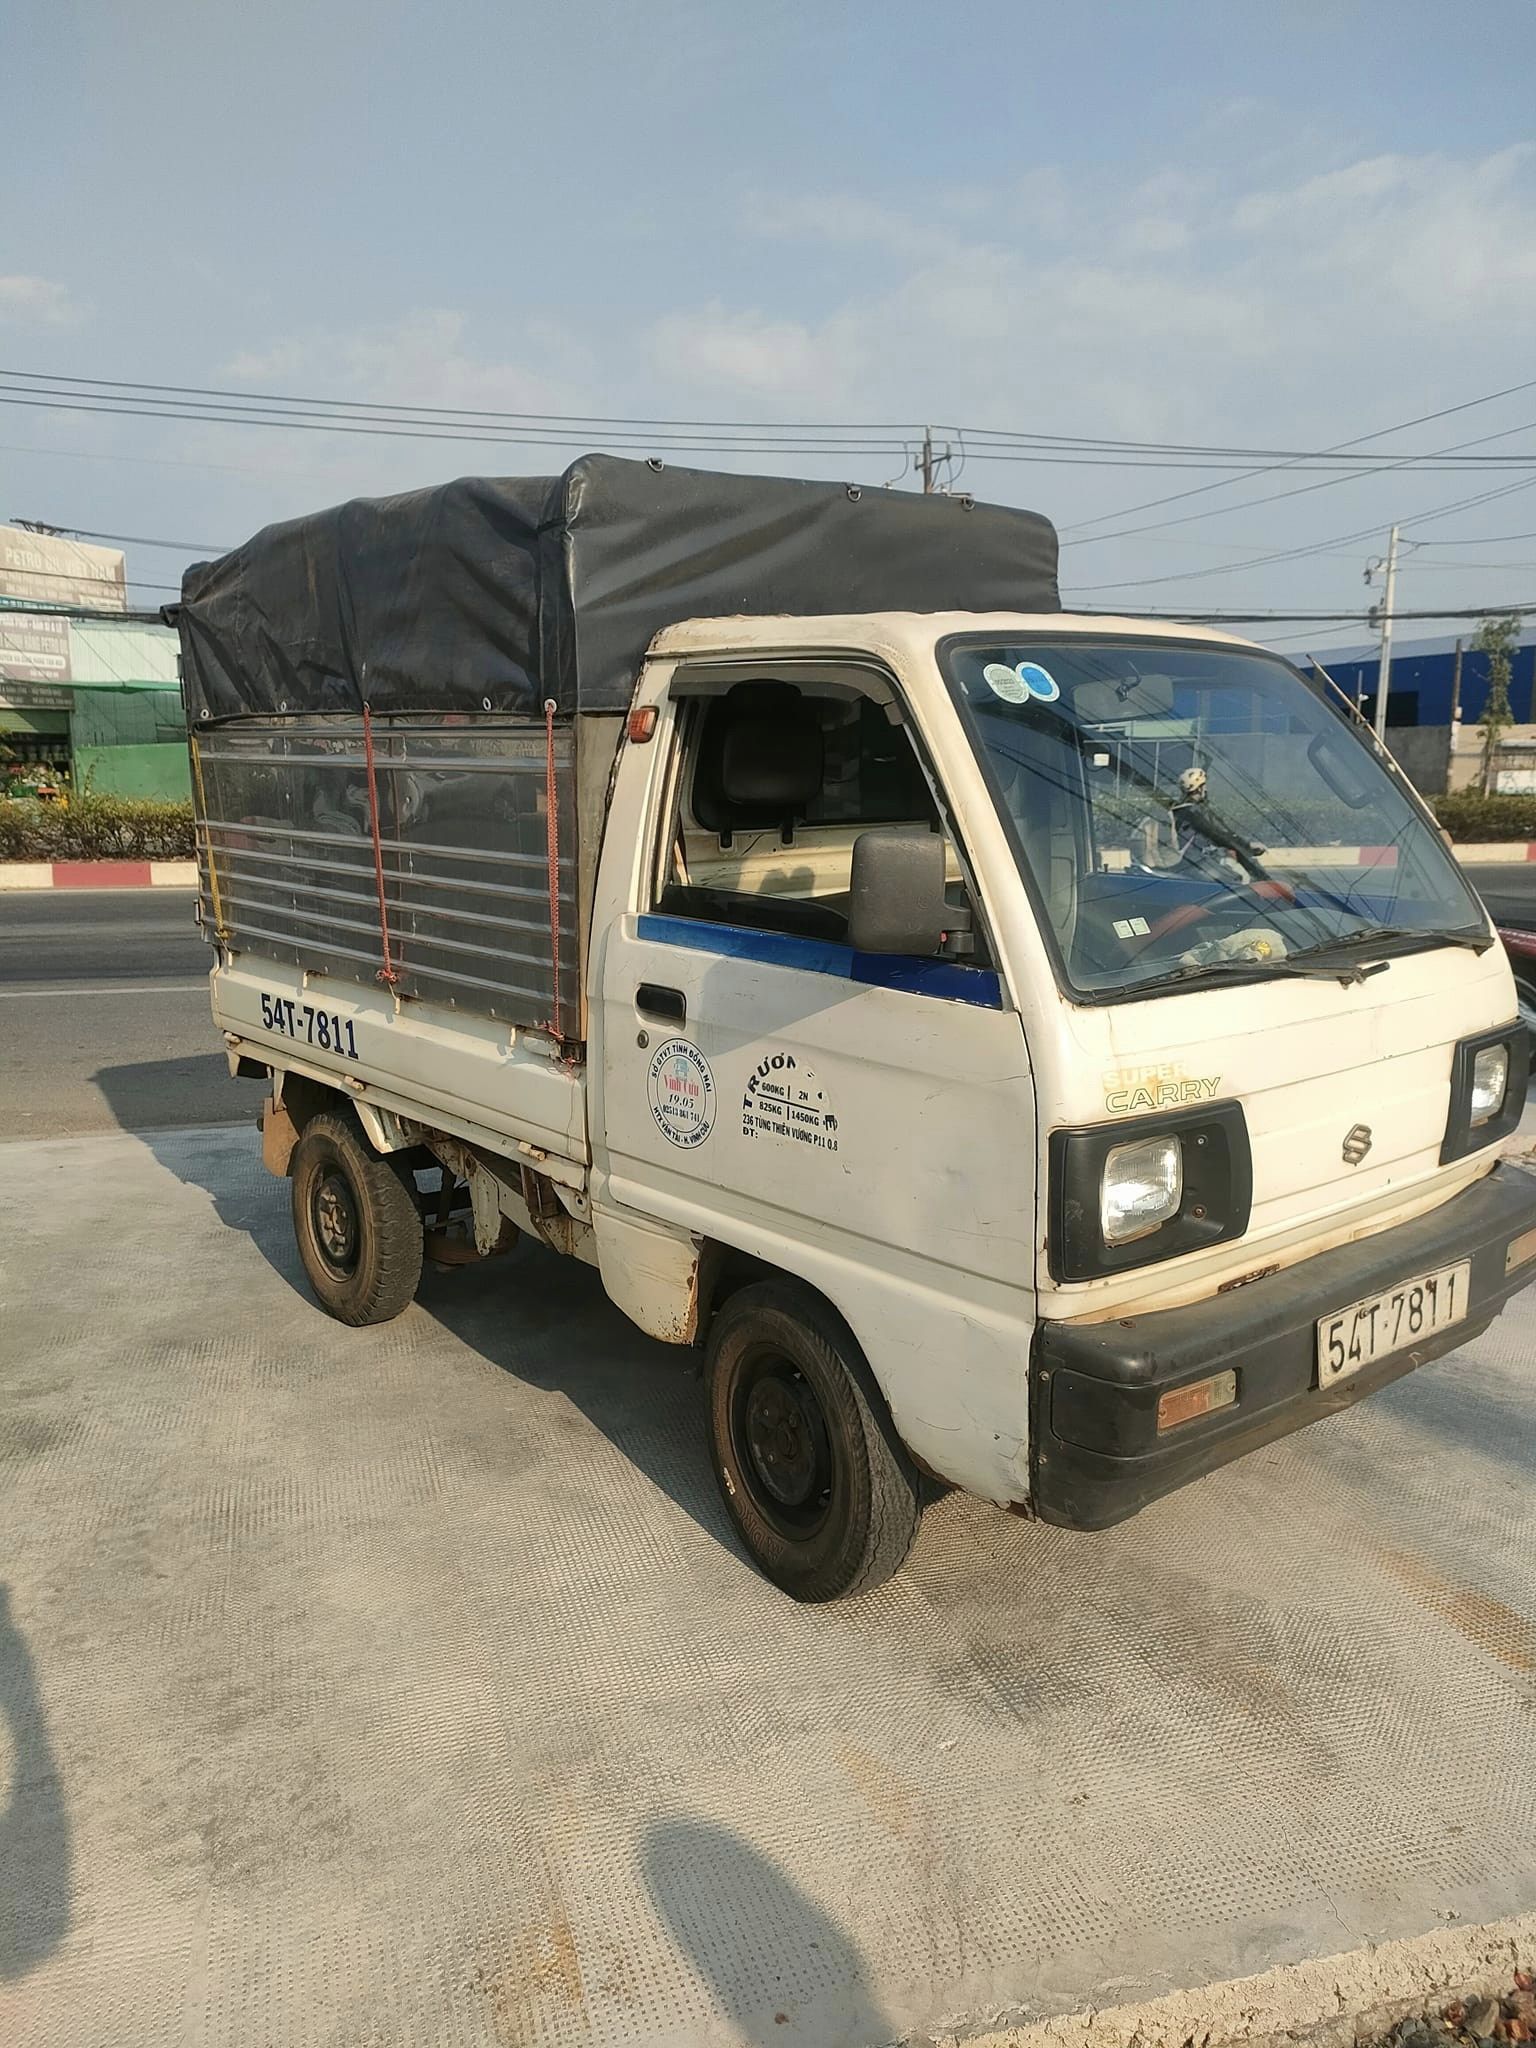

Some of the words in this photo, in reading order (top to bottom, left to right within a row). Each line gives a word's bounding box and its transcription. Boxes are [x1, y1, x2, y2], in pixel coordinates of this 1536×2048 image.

[261, 993, 359, 1060] 54T-7811
[702, 1074, 713, 1093] NAI
[761, 1082, 785, 1097] 600KG
[798, 1090, 809, 1101] 2N
[1105, 1076, 1222, 1114] CARRY
[669, 1094, 694, 1109] 19.05
[759, 1101, 782, 1116] 825KG
[791, 1110, 819, 1127] 1450KG
[743, 1113, 754, 1126] 236
[813, 1134, 825, 1149] P11
[827, 1138, 838, 1152] Q.8
